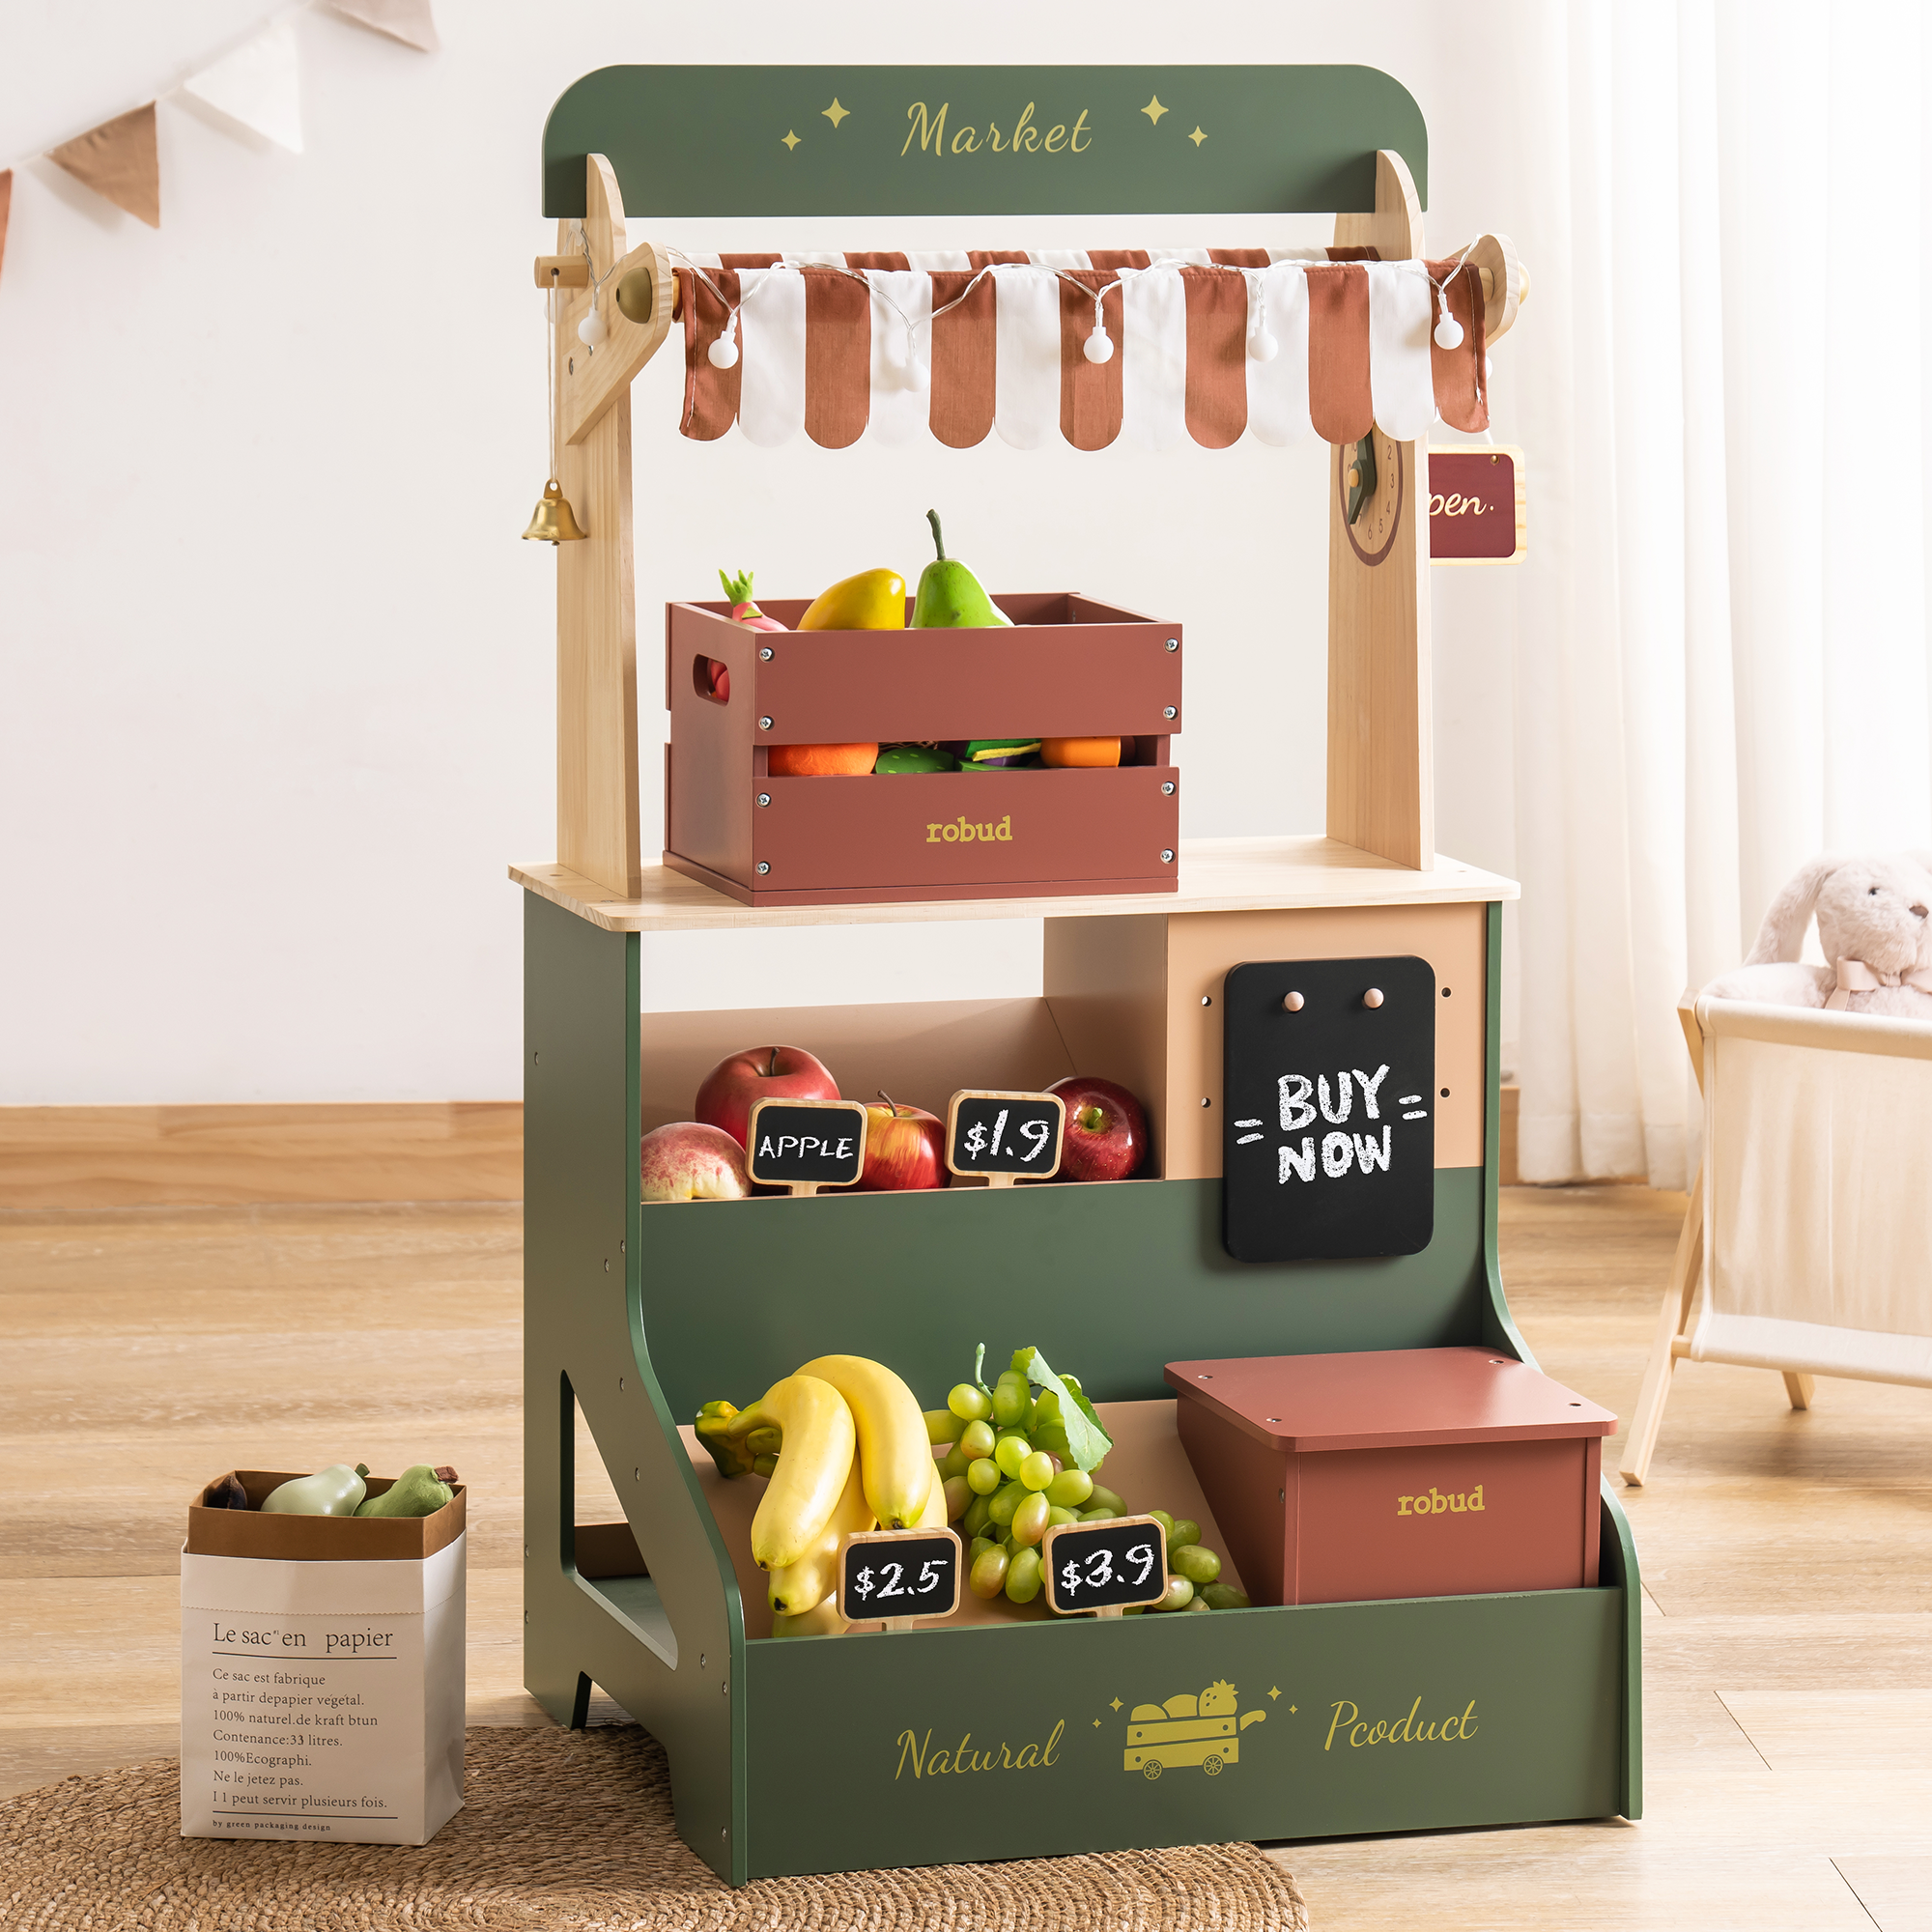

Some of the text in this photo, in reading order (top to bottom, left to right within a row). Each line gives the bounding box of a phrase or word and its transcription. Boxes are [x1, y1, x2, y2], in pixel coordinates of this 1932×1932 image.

[900, 100, 1093, 157] Market
[1387, 444, 1392, 460] 2
[1390, 473, 1395, 489] 3
[1386, 500, 1391, 515] 4
[1428, 492, 1493, 517] pen.
[1368, 524, 1373, 540] 6
[1378, 518, 1383, 533] 5
[926, 815, 1013, 842] robud
[1277, 1064, 1390, 1131] BUY
[964, 1109, 1051, 1162] $1.9
[758, 1135, 854, 1159] APPLE
[1278, 1124, 1392, 1184] NOW
[1397, 1484, 1486, 1516] robud
[854, 1560, 949, 1601] $2.5
[1061, 1544, 1155, 1597] $3.9
[213, 1623, 237, 1643] Le
[282, 1634, 307, 1647] en
[326, 1628, 393, 1654] papier
[213, 1668, 326, 1688] Ce sac est fabrique
[213, 1689, 219, 1700] à
[222, 1691, 255, 1704] partir
[213, 1710, 245, 1722] 100%
[315, 1715, 345, 1726] kraft
[348, 1715, 379, 1726] btun
[308, 1735, 343, 1747] litres.
[895, 1719, 1065, 1780] Natural
[213, 1771, 303, 1788] Ne le jetez pas.
[232, 1794, 259, 1806] peut
[263, 1795, 298, 1806] servir
[300, 1795, 357, 1809] plusieurs
[361, 1796, 387, 1808] fois.
[254, 1822, 299, 1832] packaging
[302, 1823, 331, 1833] design
